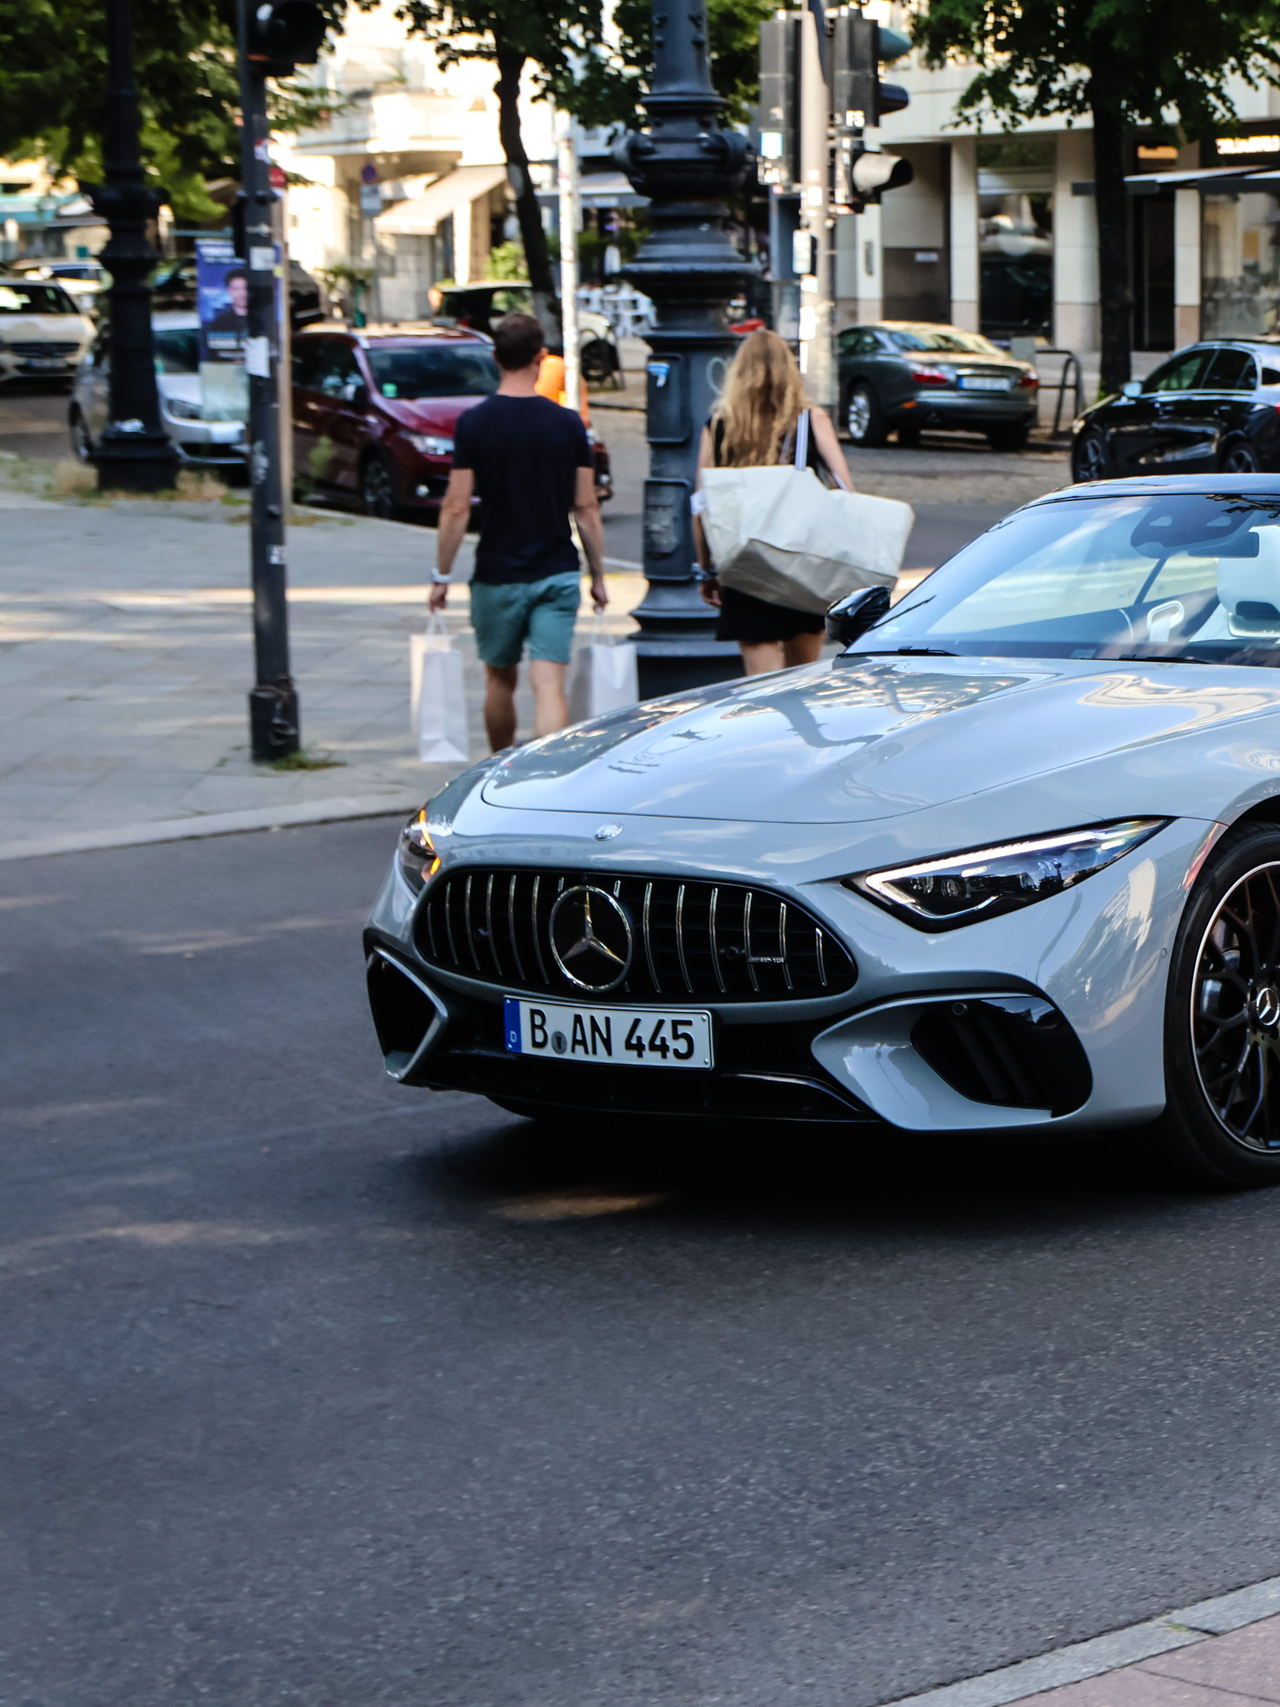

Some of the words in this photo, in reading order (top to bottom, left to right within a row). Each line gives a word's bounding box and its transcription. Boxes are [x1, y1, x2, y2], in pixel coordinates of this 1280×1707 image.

[529, 1008, 548, 1049] B
[571, 1013, 613, 1057] AN
[624, 1017, 695, 1060] 445
